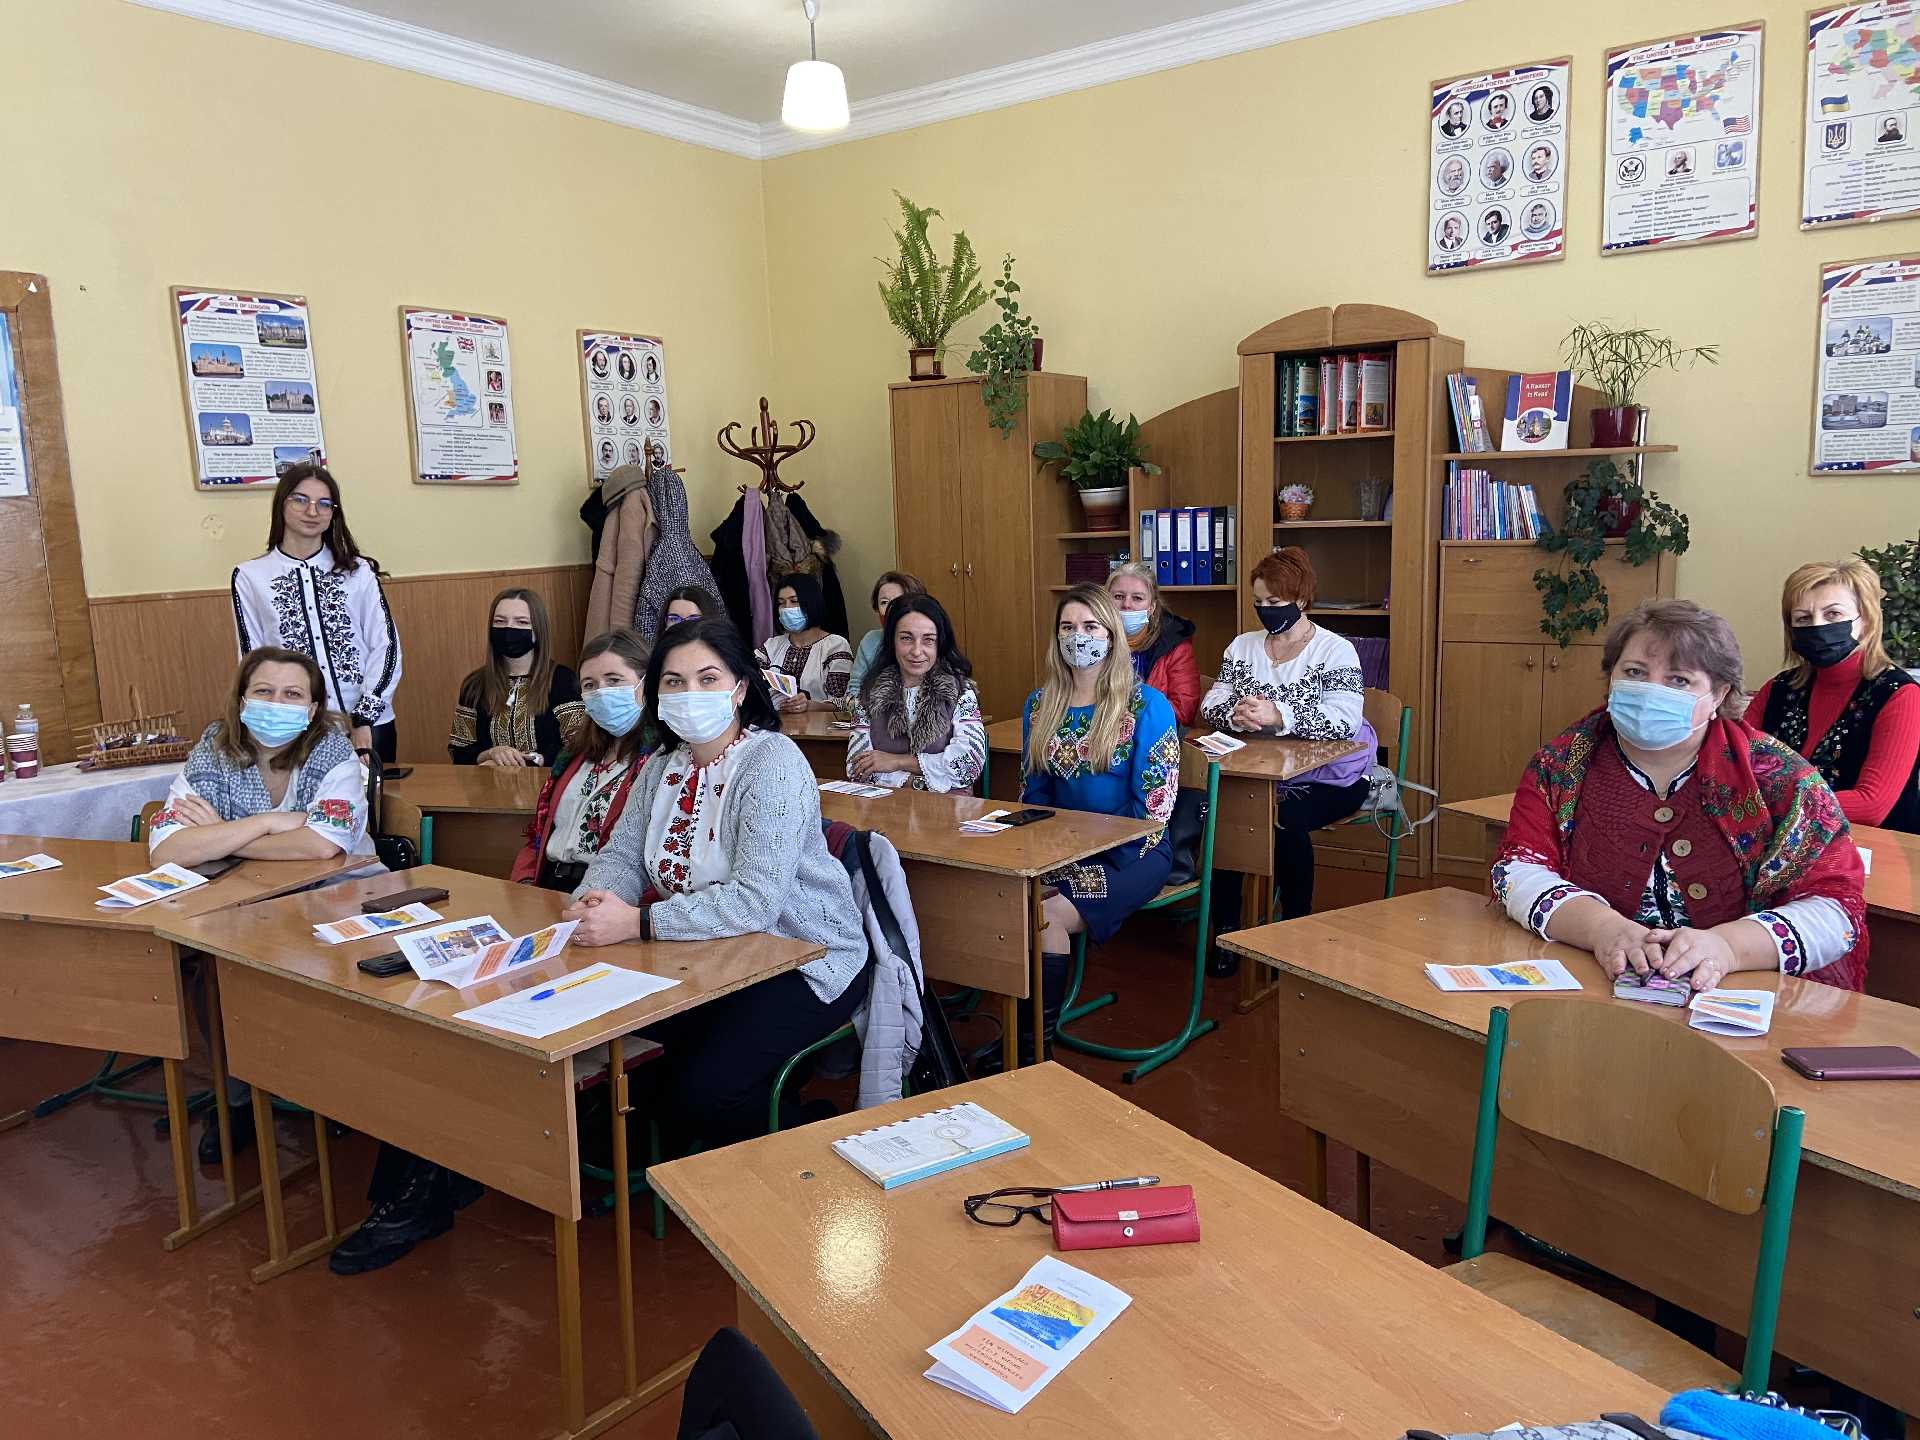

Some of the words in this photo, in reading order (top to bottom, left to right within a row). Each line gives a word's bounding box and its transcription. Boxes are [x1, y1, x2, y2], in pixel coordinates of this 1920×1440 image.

[1632, 53, 1644, 61] THE
[1646, 50, 1669, 59] UNITED
[1670, 46, 1693, 56] STATES
[1695, 43, 1704, 51] OF
[1705, 38, 1735, 49] AMERICA
[1455, 82, 1484, 93] AMERICAN
[1485, 79, 1504, 88] POETS
[1505, 76, 1518, 84] AND
[1518, 72, 1544, 83] WRITERS
[1880, 267, 1906, 275] SIGHTS
[248, 302, 270, 310] LONDON
